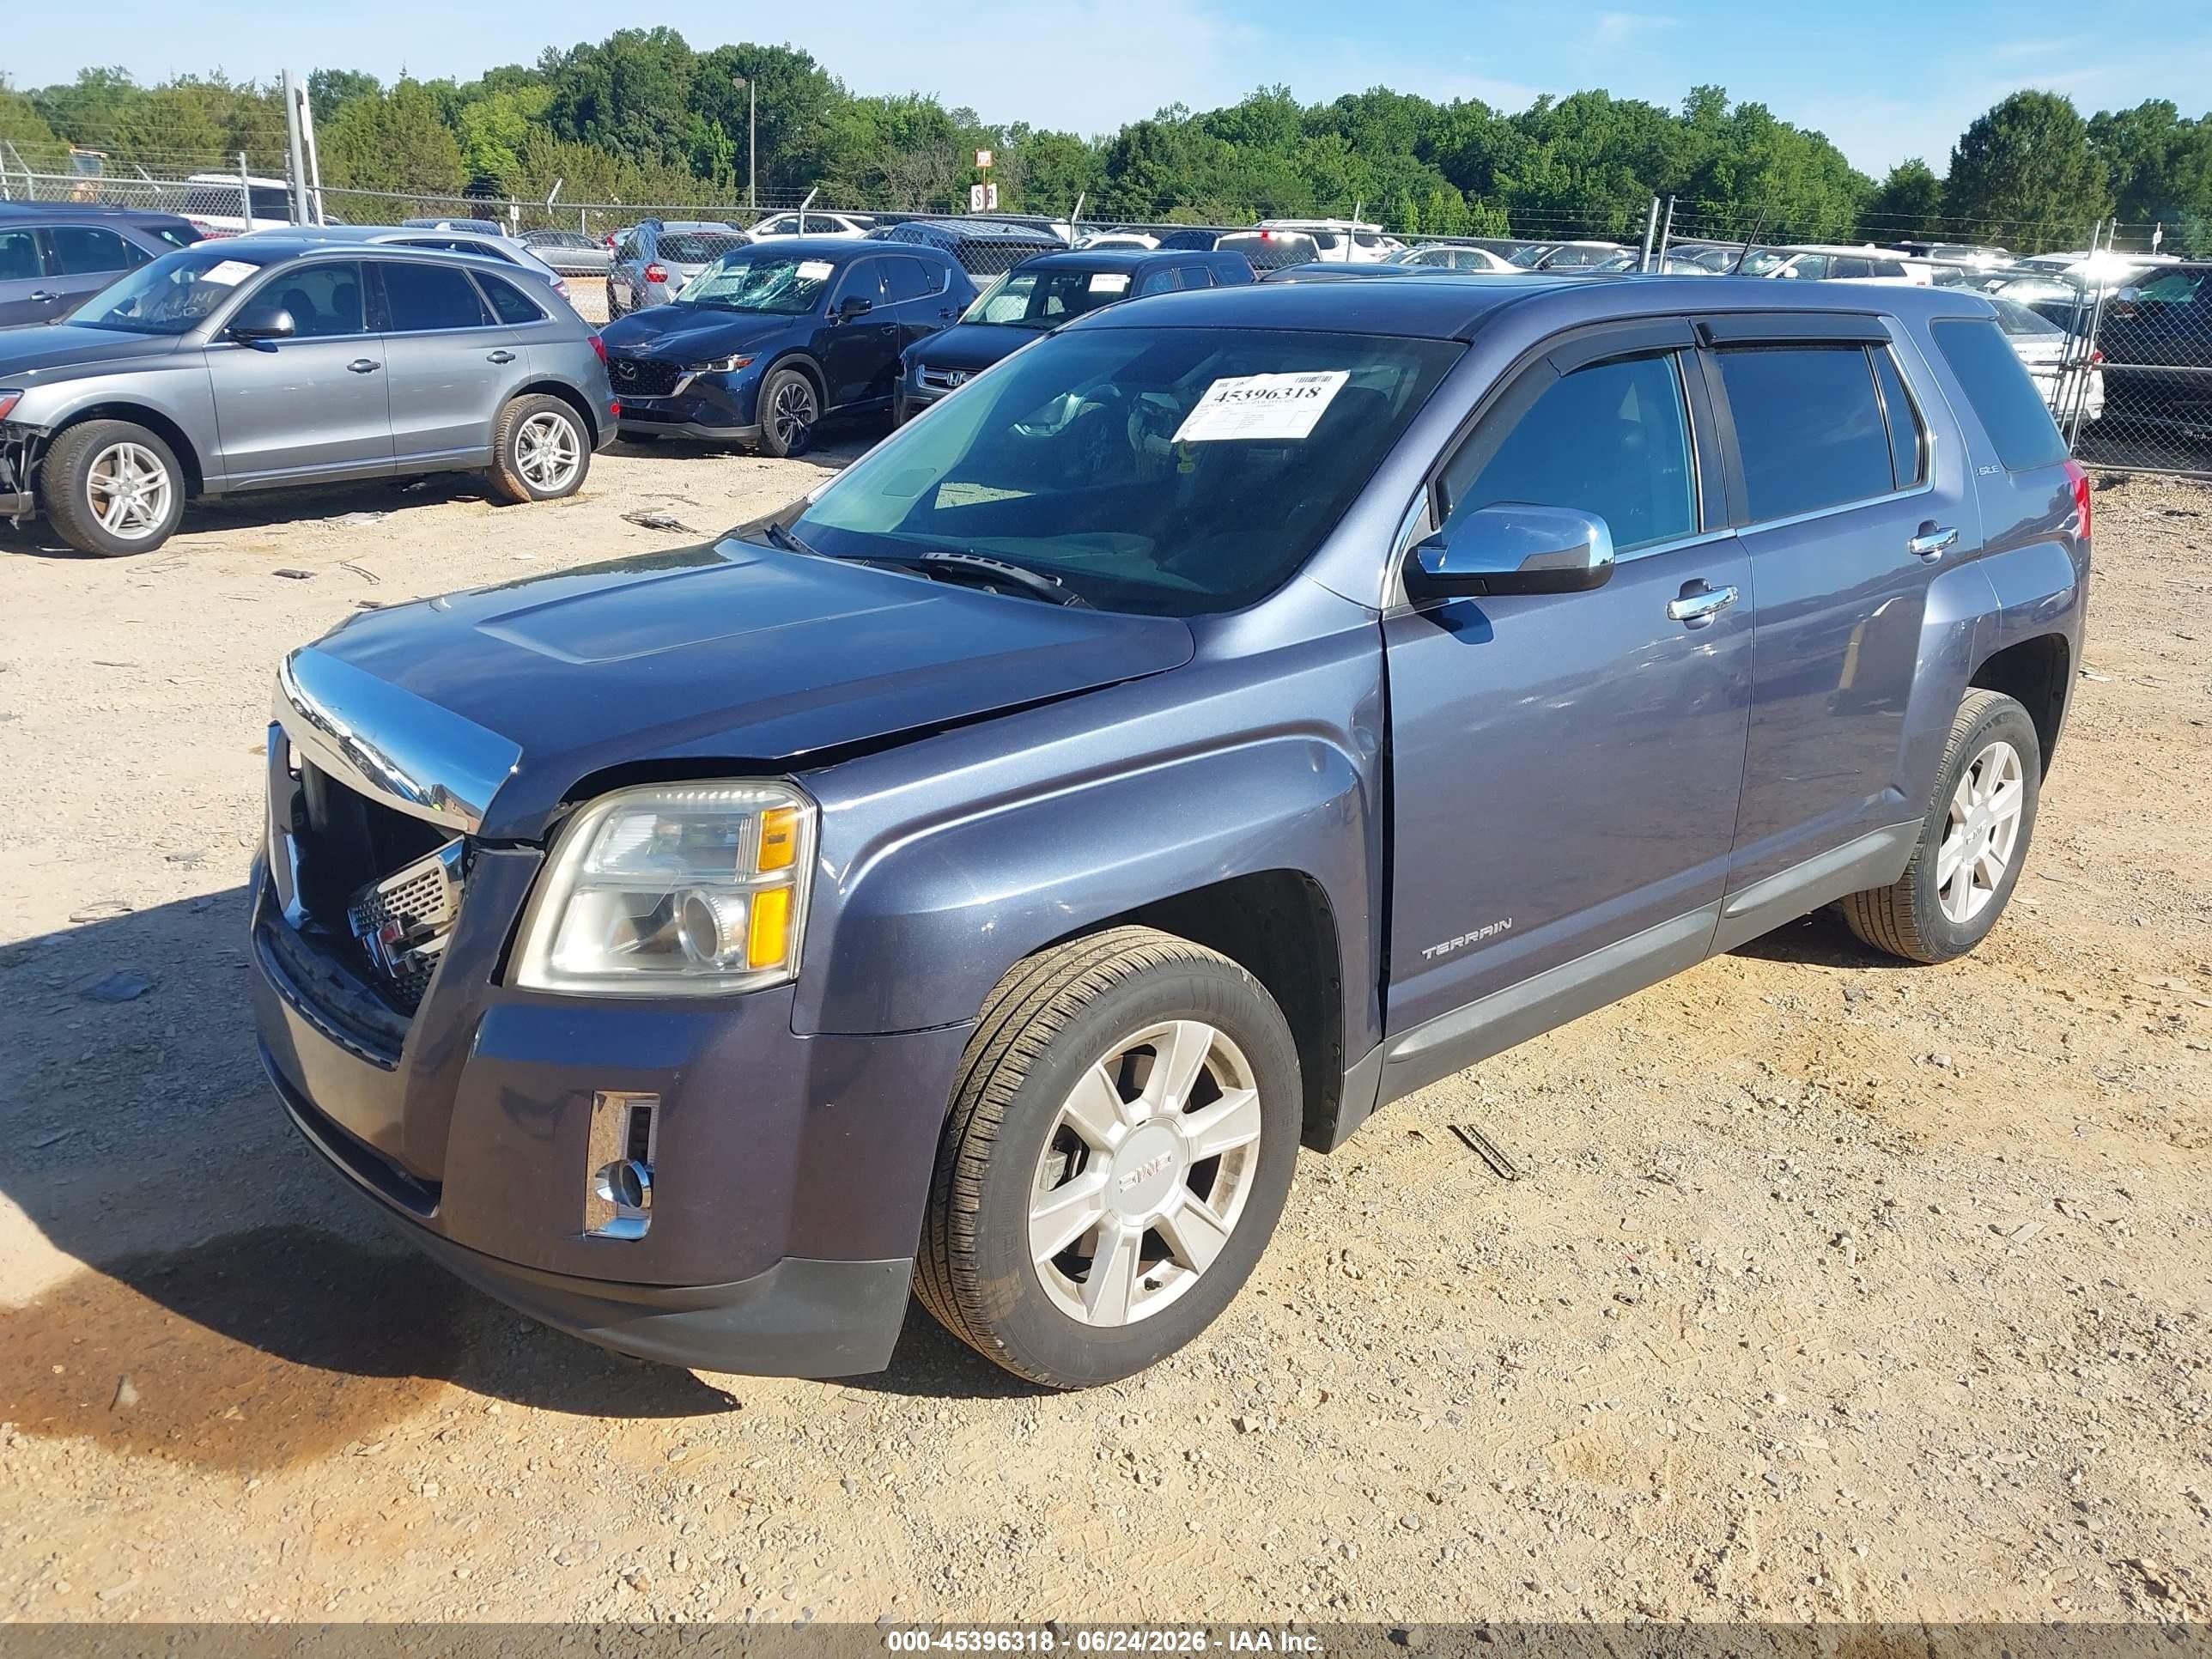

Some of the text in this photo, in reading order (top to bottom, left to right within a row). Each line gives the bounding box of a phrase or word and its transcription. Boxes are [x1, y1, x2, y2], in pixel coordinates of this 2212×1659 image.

[975, 190, 981, 207] S
[1213, 386, 1322, 403] 45396318
[1421, 917, 1512, 961] TERRAIN
